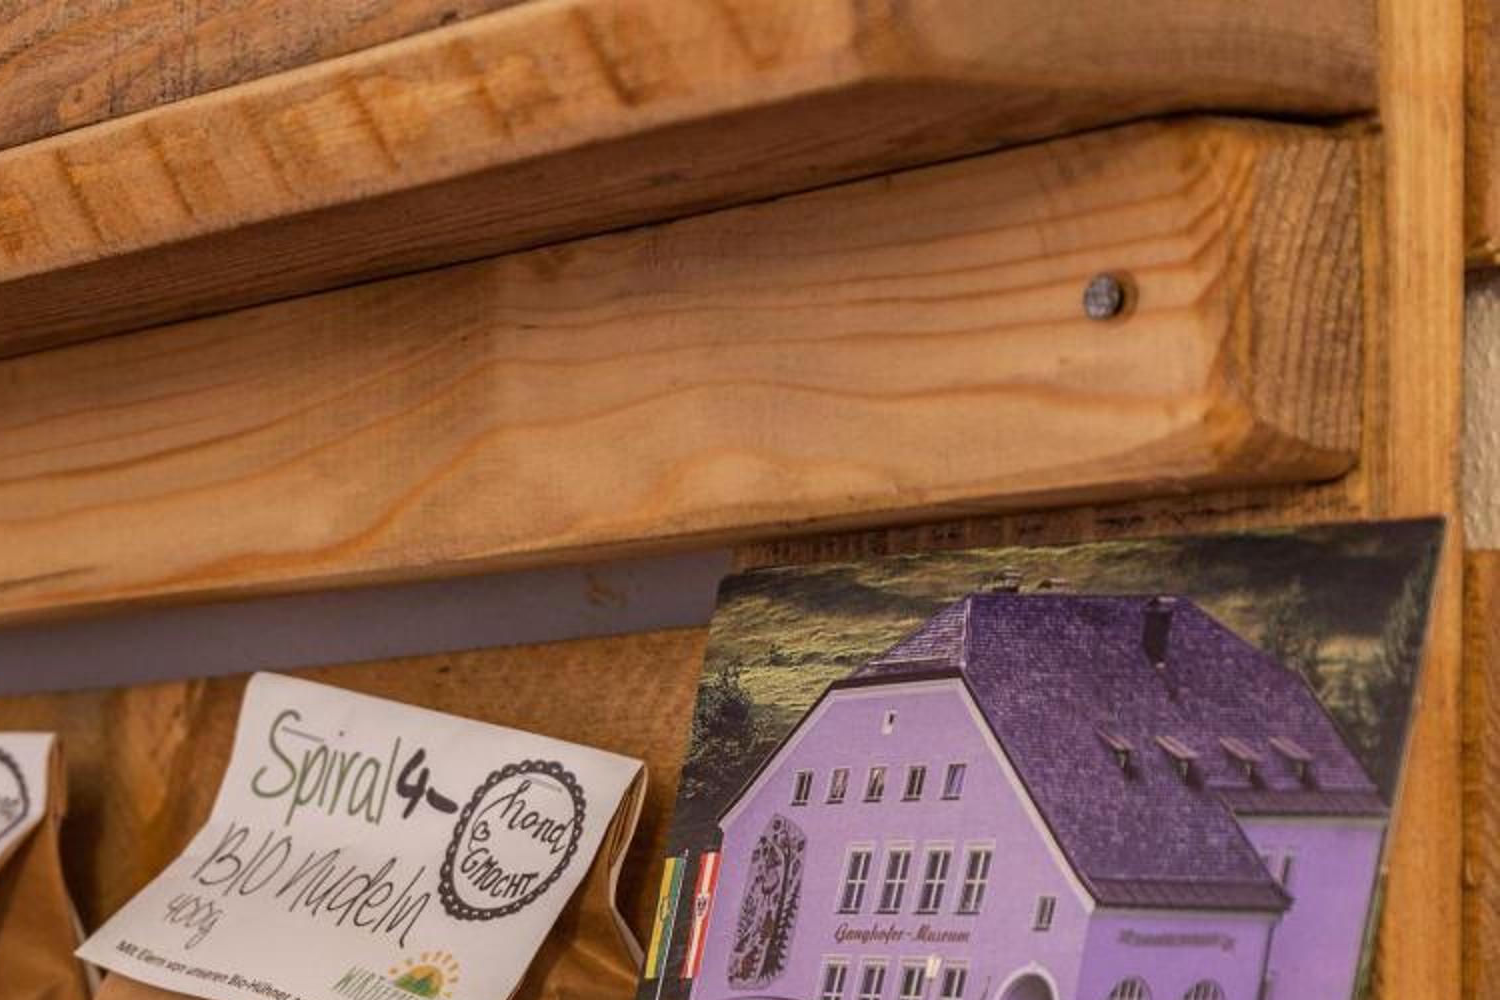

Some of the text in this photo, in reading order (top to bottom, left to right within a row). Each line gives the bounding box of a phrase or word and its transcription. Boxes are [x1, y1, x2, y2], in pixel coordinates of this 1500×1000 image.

[251, 709, 401, 826] Spiral
[191, 822, 430, 948] BIO Nudeln
